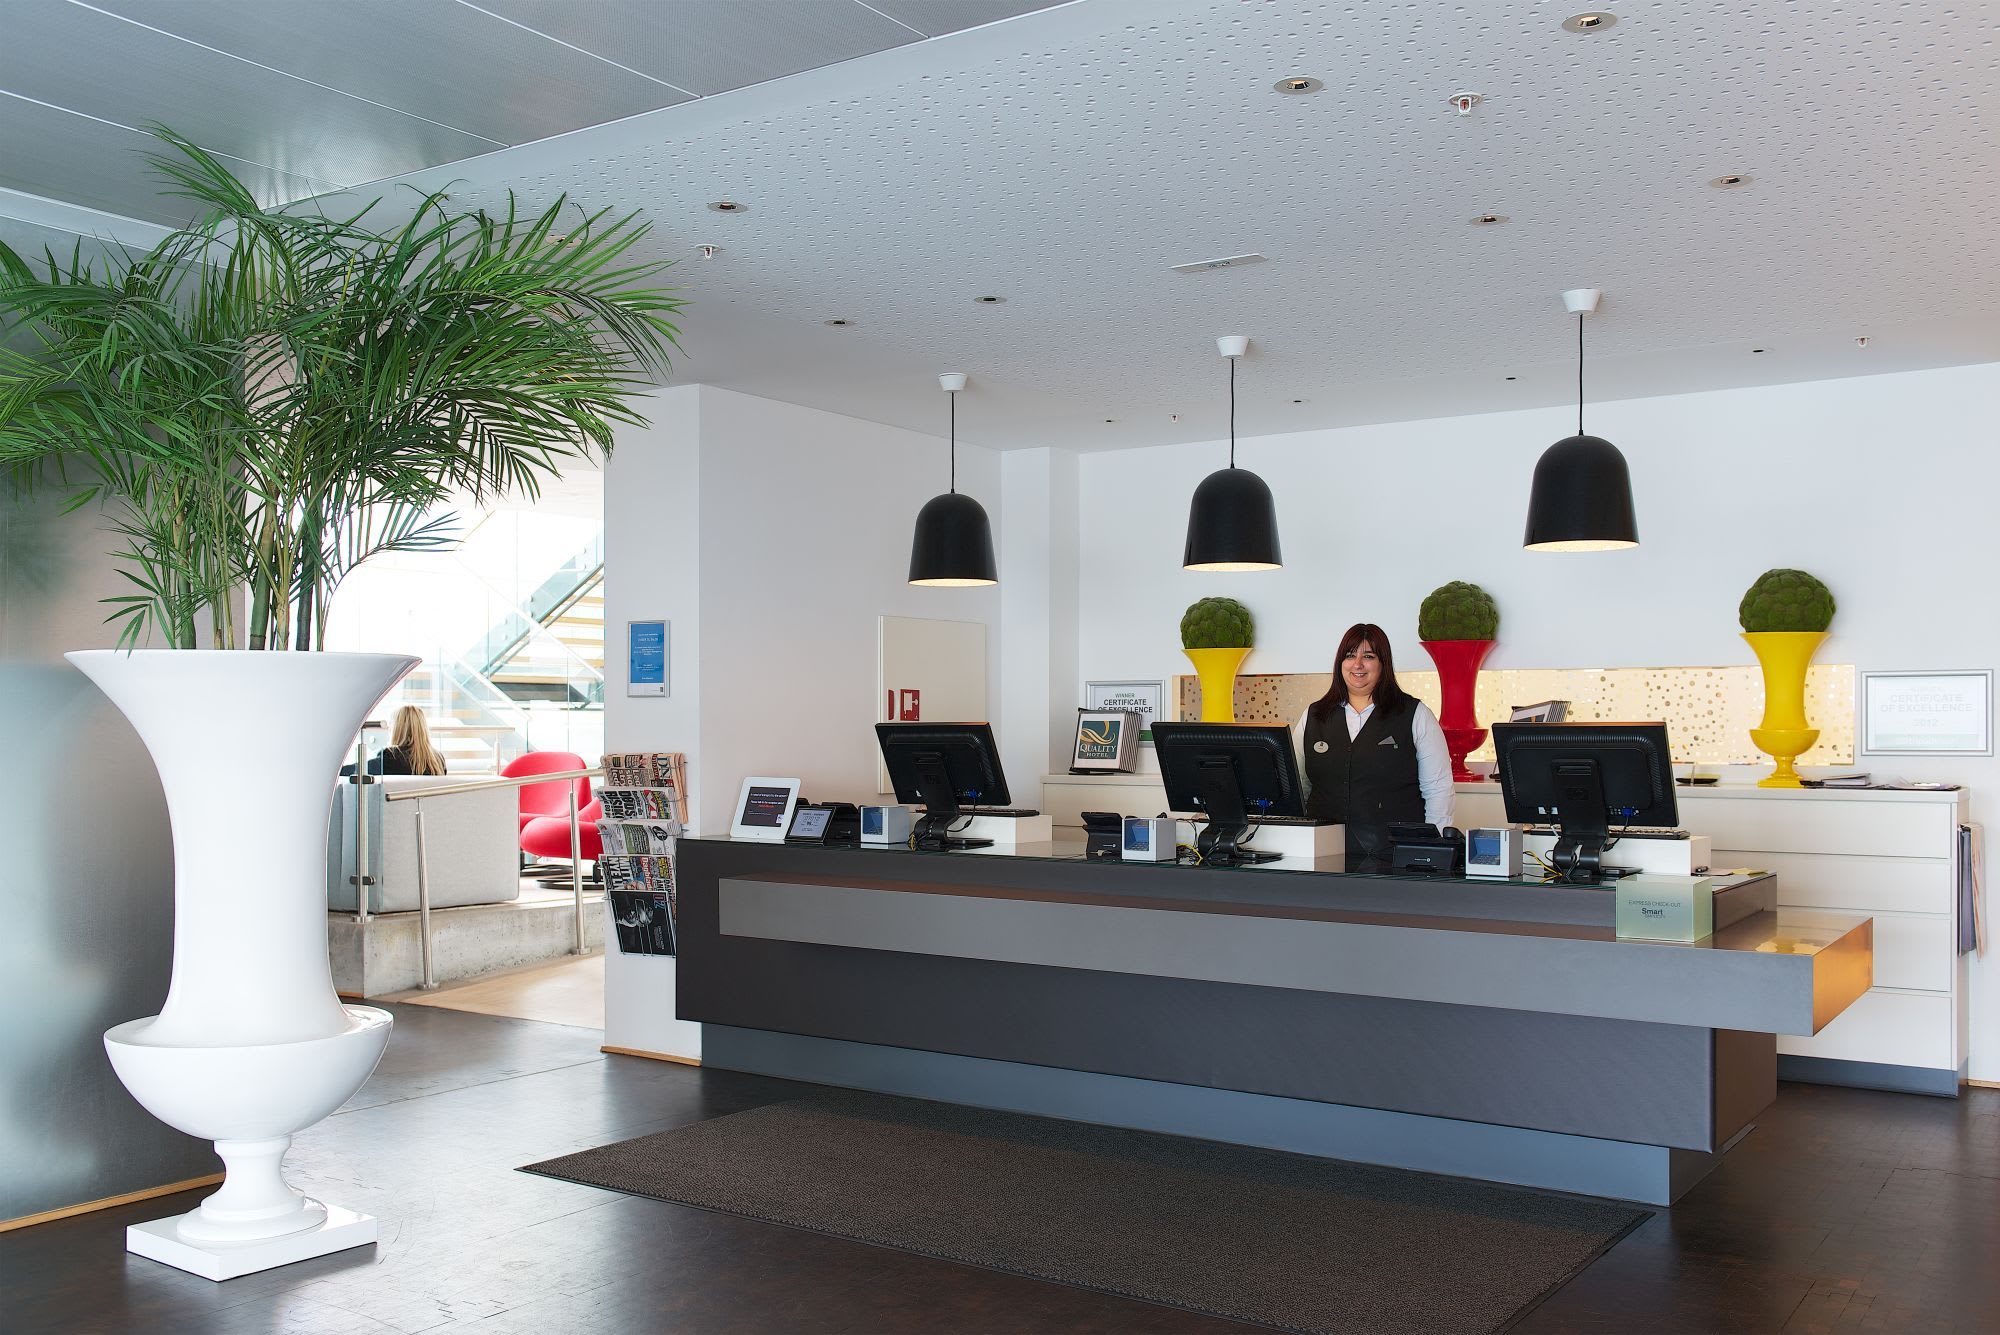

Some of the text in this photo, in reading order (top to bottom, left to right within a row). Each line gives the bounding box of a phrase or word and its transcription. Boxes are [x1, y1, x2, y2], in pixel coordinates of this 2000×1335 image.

[1080, 743, 1117, 753] QUALITY
[657, 757, 671, 779] DN
[1641, 907, 1663, 915] Smart
